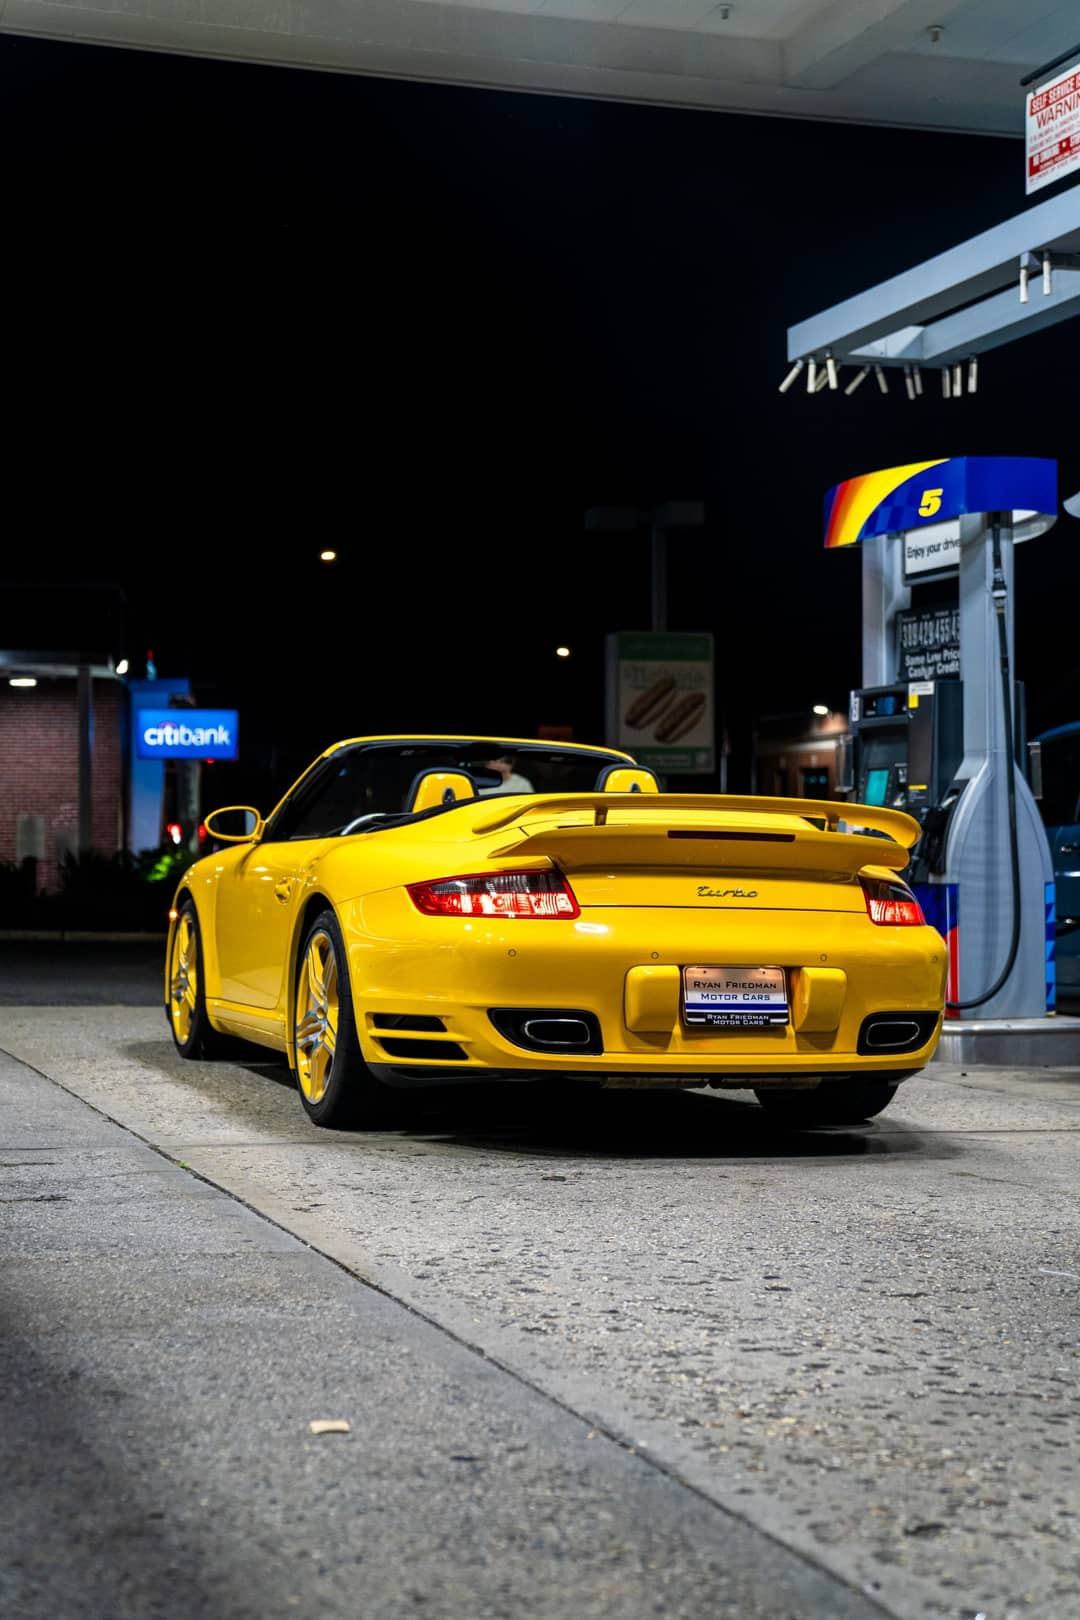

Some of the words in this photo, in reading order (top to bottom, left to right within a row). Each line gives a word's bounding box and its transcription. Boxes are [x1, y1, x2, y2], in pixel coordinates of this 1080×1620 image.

[1032, 93, 1047, 112] SELF
[918, 488, 944, 517] 5
[907, 545, 925, 559] Enjoy
[926, 542, 941, 558] your
[905, 654, 925, 666] Same
[926, 651, 942, 664] Low
[936, 660, 959, 675] Credit
[143, 724, 231, 746] citibank
[693, 981, 720, 989] RYAN
[726, 981, 777, 989] FRIEDMAN
[701, 993, 737, 1001] MOTOR
[743, 993, 770, 1001] CARS
